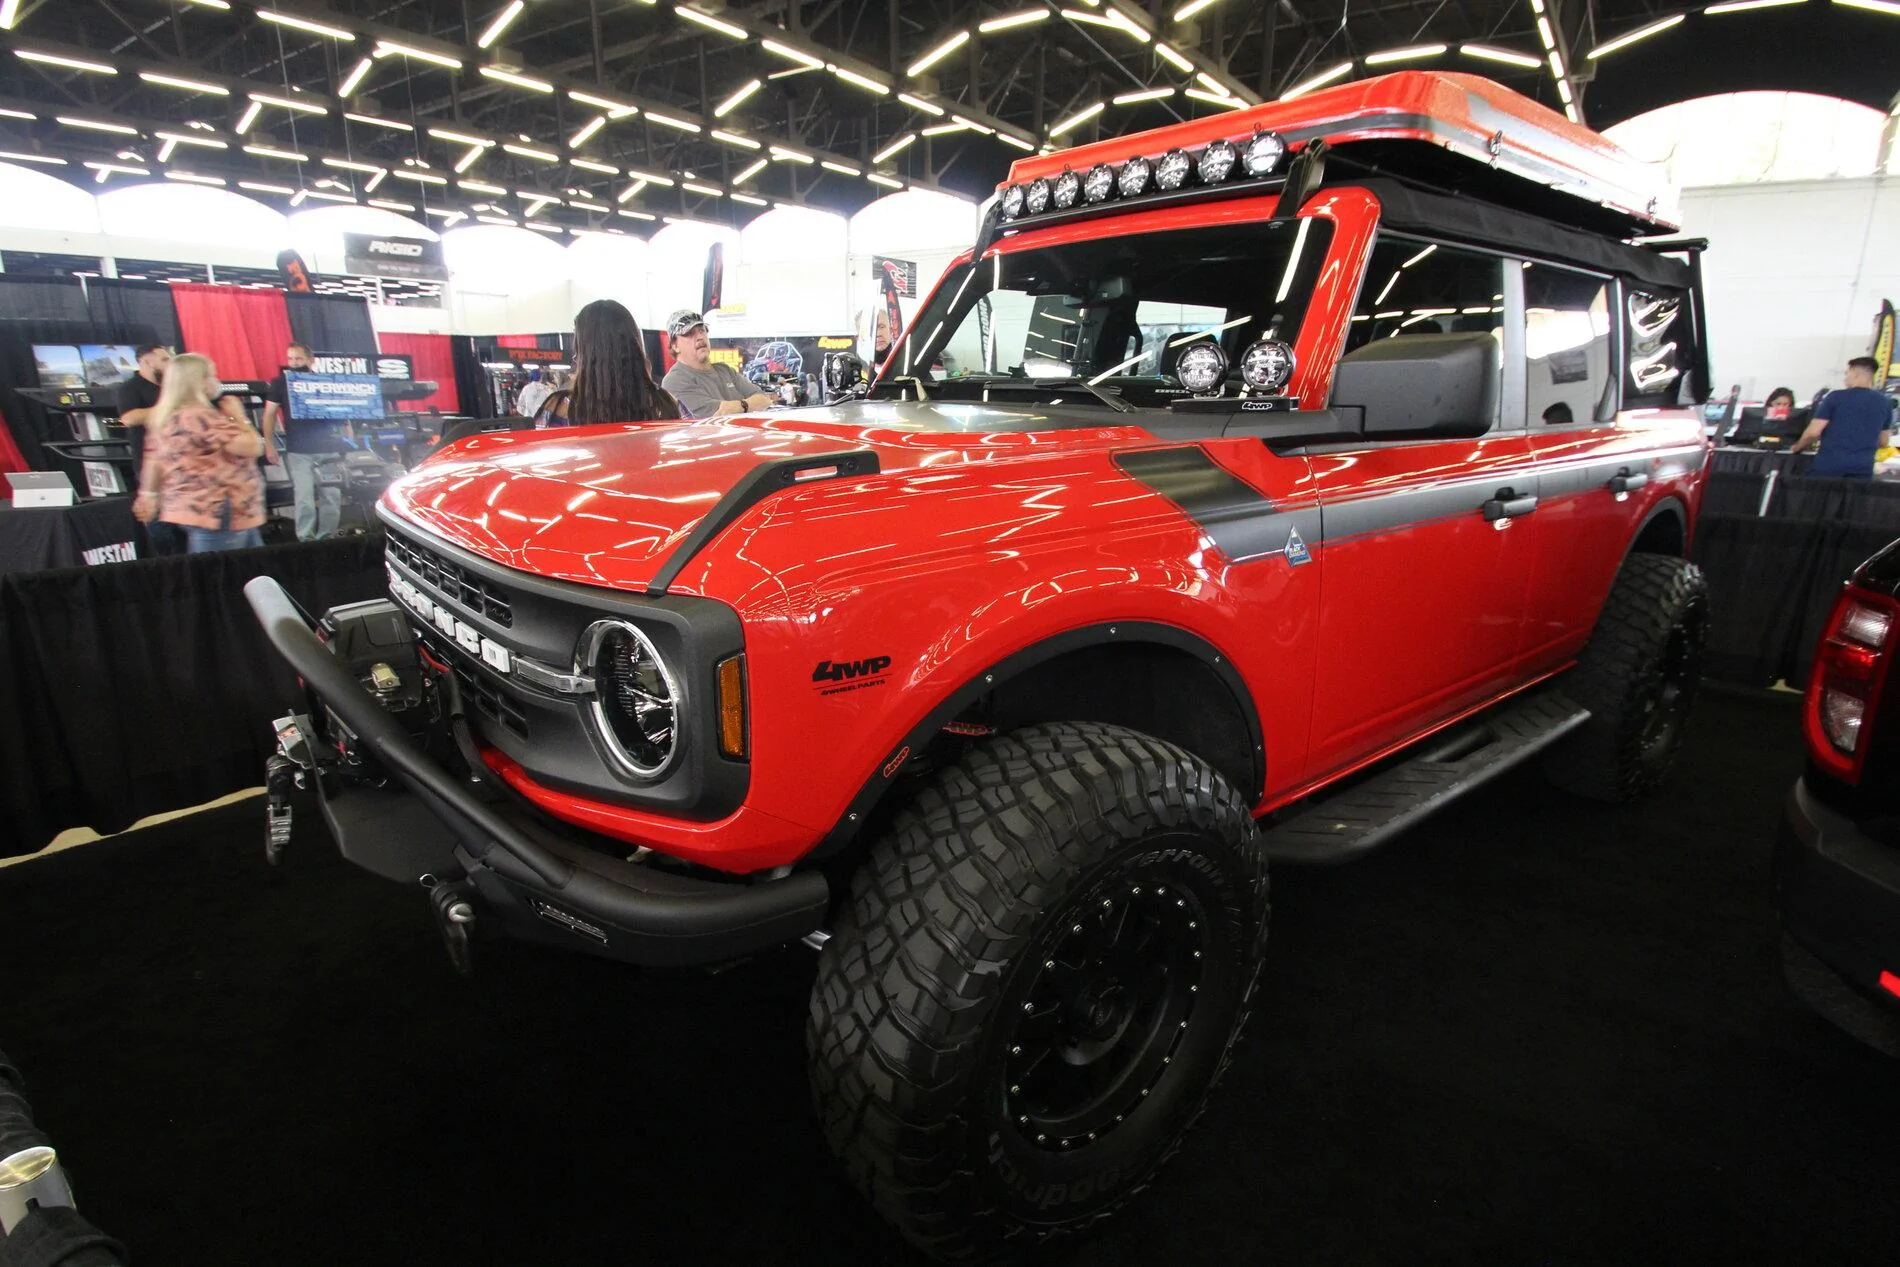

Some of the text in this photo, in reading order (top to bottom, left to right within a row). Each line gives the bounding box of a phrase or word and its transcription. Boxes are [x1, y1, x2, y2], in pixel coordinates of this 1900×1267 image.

[368, 240, 423, 257] RIGID
[293, 382, 377, 395] SUPERWINCH
[1242, 402, 1273, 411] 4WP
[388, 567, 511, 674] BRONCO
[812, 656, 892, 682] 4WP
